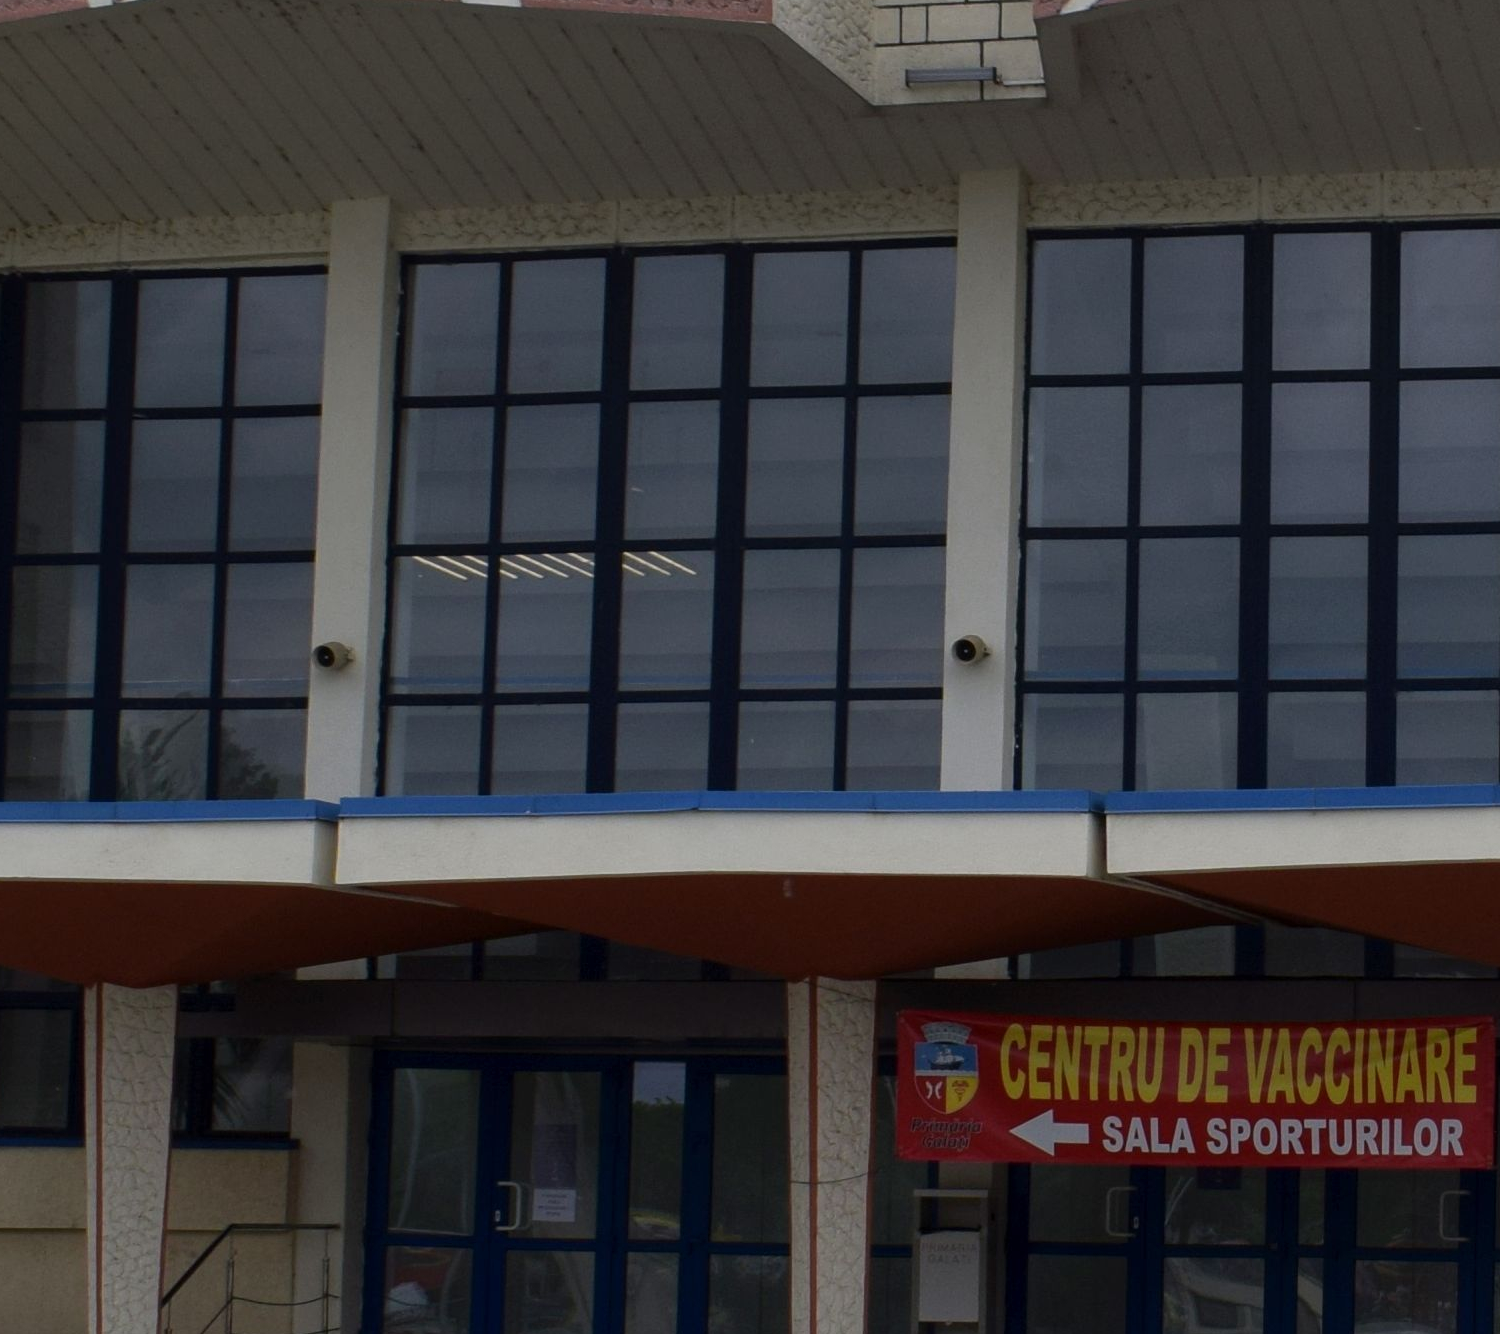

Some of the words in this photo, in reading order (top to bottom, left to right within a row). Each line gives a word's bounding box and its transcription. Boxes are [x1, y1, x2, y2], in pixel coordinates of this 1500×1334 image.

[1000, 1022, 1163, 1103] CENTRU
[1179, 1026, 1230, 1104] DE
[1245, 1027, 1478, 1105] VACCINARE
[1102, 1115, 1196, 1155] SALA
[1206, 1117, 1464, 1157] SPORTURILOR
